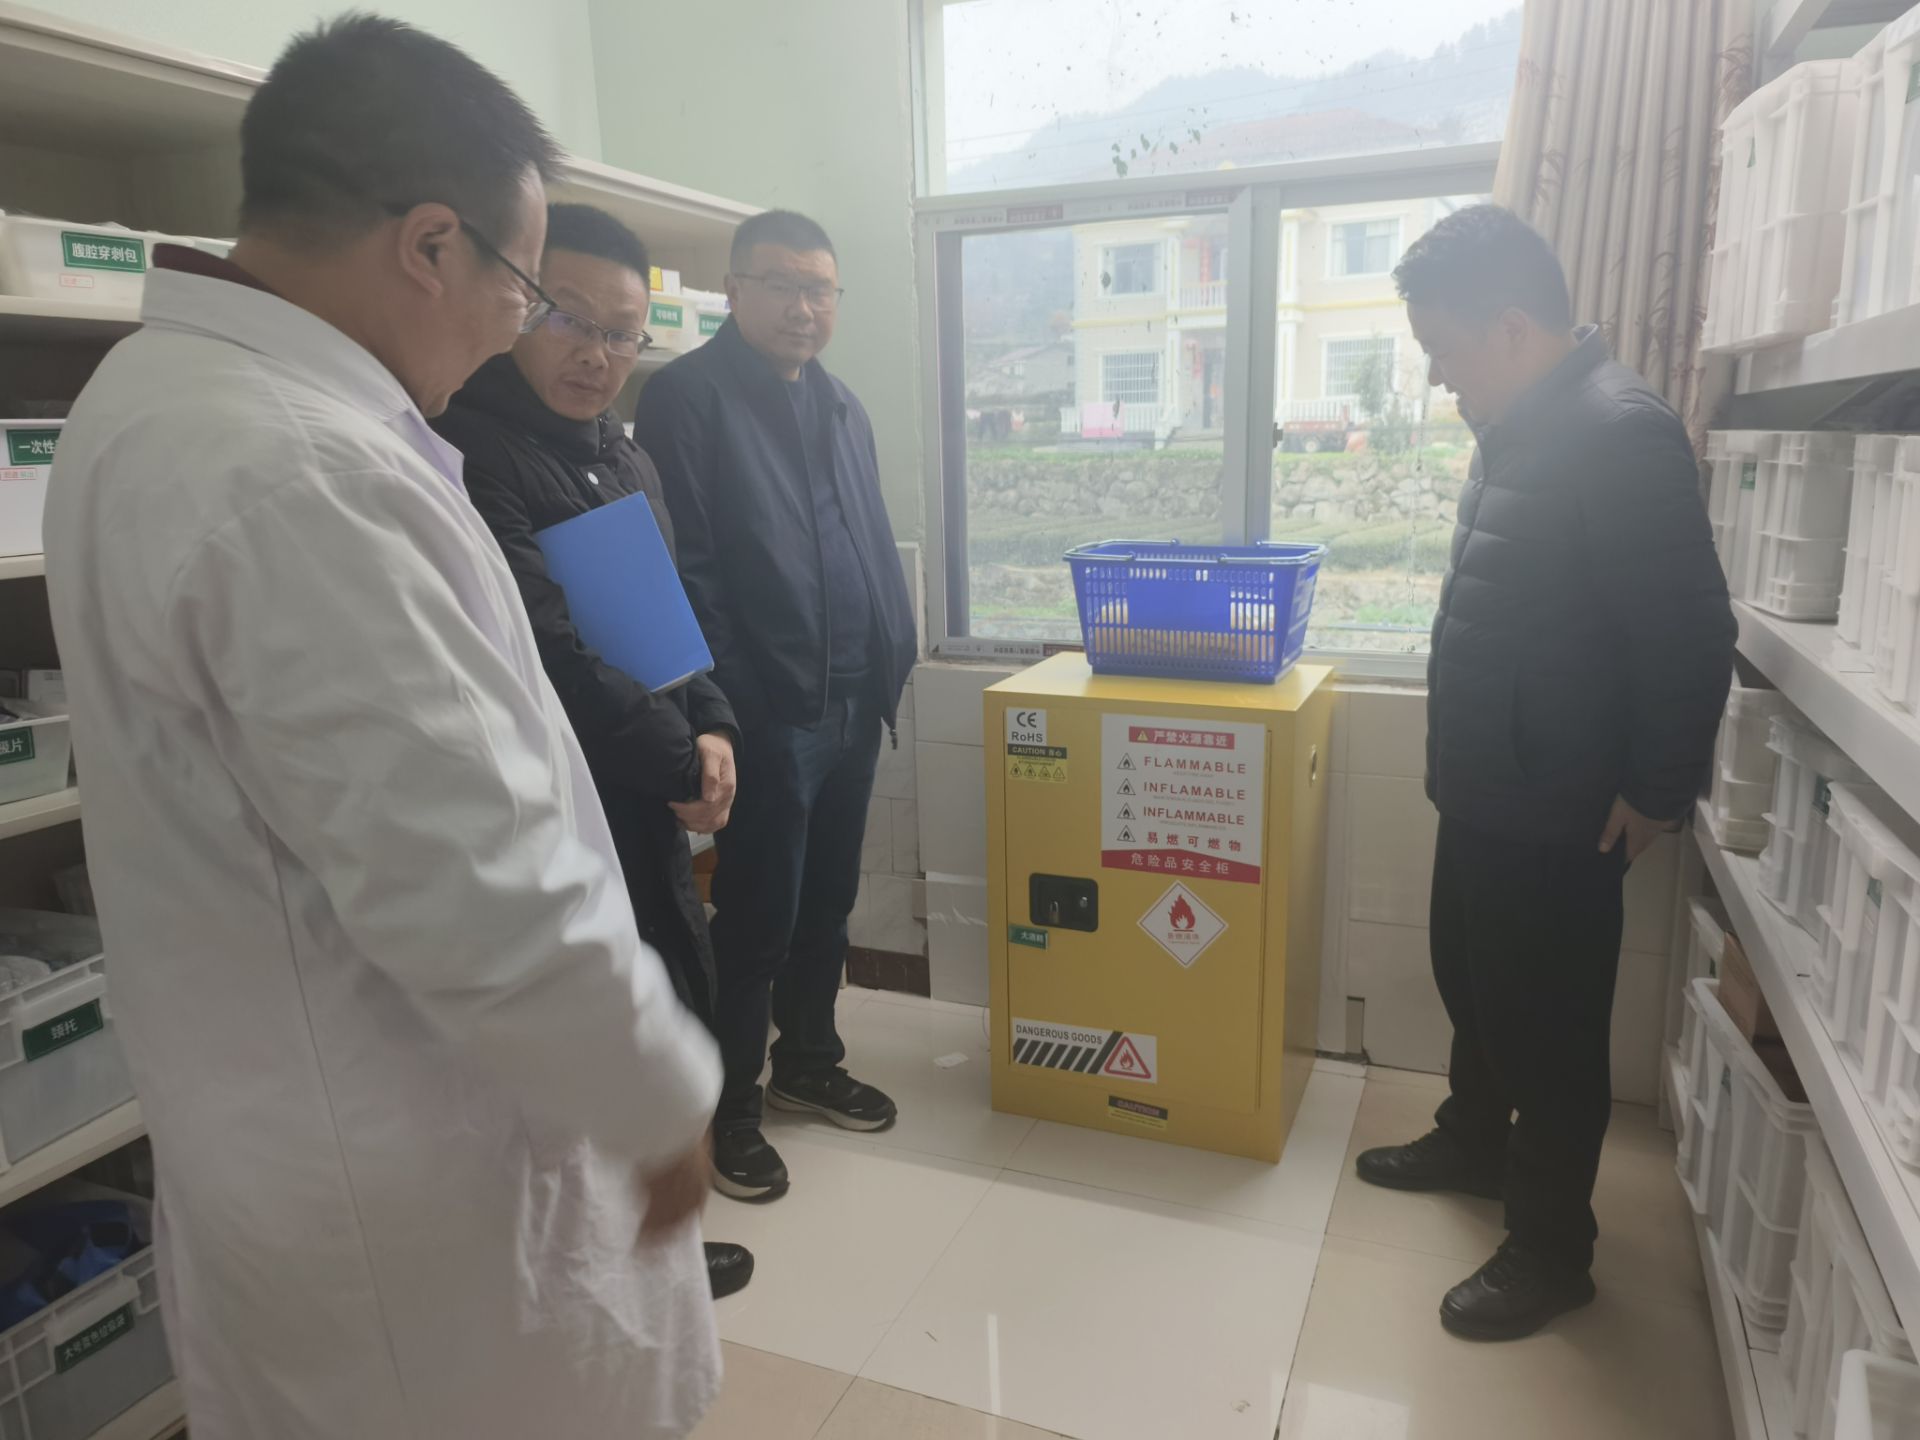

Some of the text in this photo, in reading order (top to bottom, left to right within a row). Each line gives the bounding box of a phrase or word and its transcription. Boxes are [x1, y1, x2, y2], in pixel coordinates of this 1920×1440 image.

[71, 242, 138, 263] 腹腔穿刺包
[18, 439, 58, 455] 一次性
[1016, 711, 1037, 728] CE
[1011, 731, 1043, 743] RoHS
[1153, 730, 1228, 747] 严禁火源靠近
[1012, 746, 1046, 755] CAUTION
[1143, 756, 1247, 774] FLAMMABLE
[1143, 782, 1246, 800] INFLAMABLE
[1143, 806, 1245, 825] INFLAMMABLE
[1147, 831, 1241, 851] 易燃可燃物
[1131, 852, 1230, 874] 危险品安全柜
[1016, 1024, 1103, 1045] DANGEROUS GOODS
[1116, 1099, 1160, 1117] CAUTION
